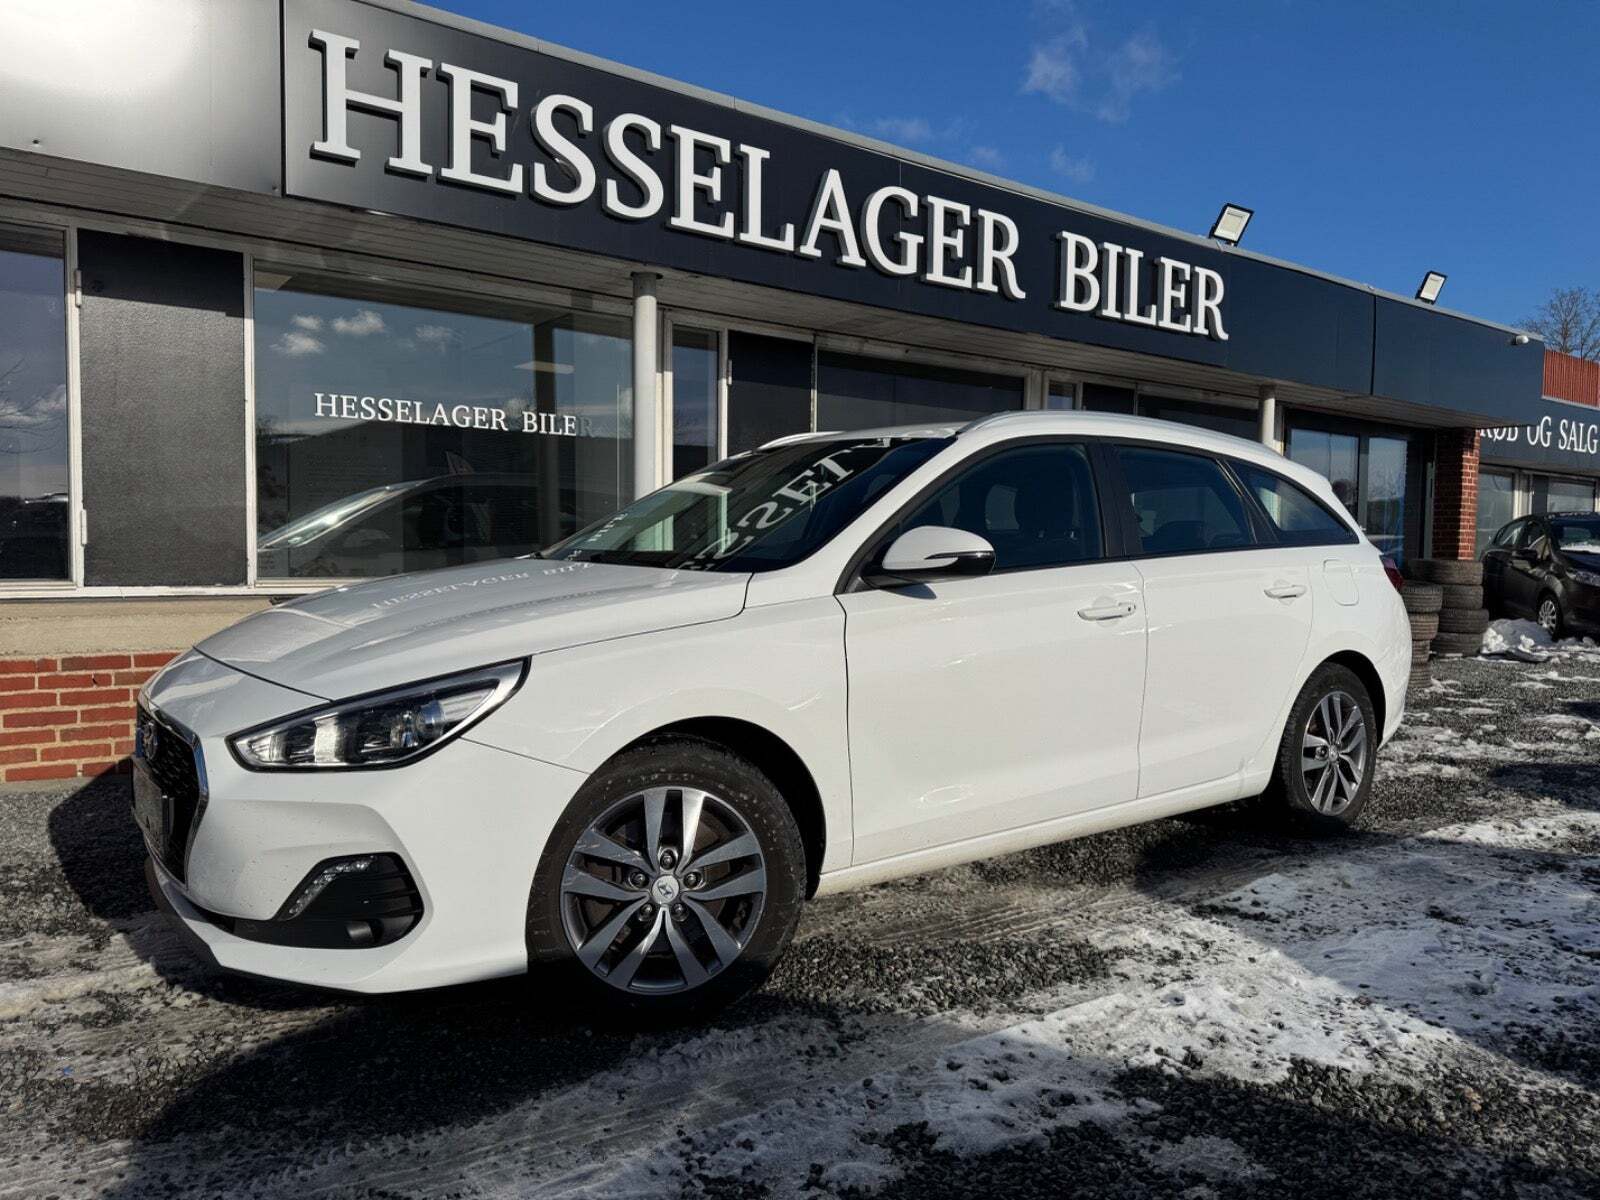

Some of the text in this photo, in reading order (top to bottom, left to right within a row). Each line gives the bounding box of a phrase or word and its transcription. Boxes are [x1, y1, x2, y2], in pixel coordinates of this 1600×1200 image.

[309, 29, 1229, 341] HESSELAGER BILER
[314, 392, 594, 438] HESSELAGER BILER
[1558, 419, 1599, 455] SALG
